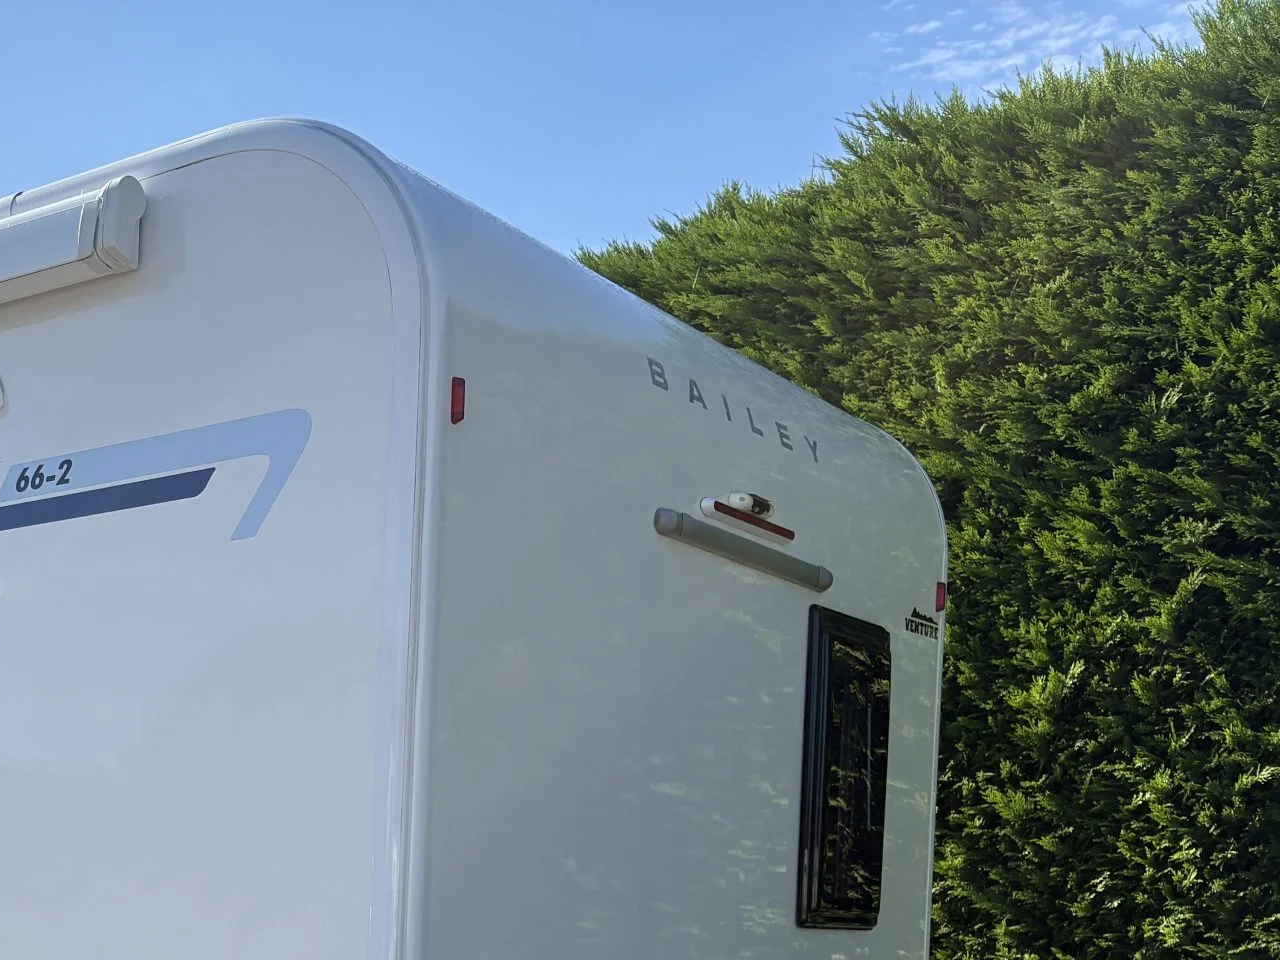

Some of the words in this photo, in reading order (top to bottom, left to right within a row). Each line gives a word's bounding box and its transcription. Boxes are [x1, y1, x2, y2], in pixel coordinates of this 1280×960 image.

[647, 356, 818, 463] BAILEY
[16, 459, 72, 492] 66-2
[905, 617, 939, 640] VENTURE
